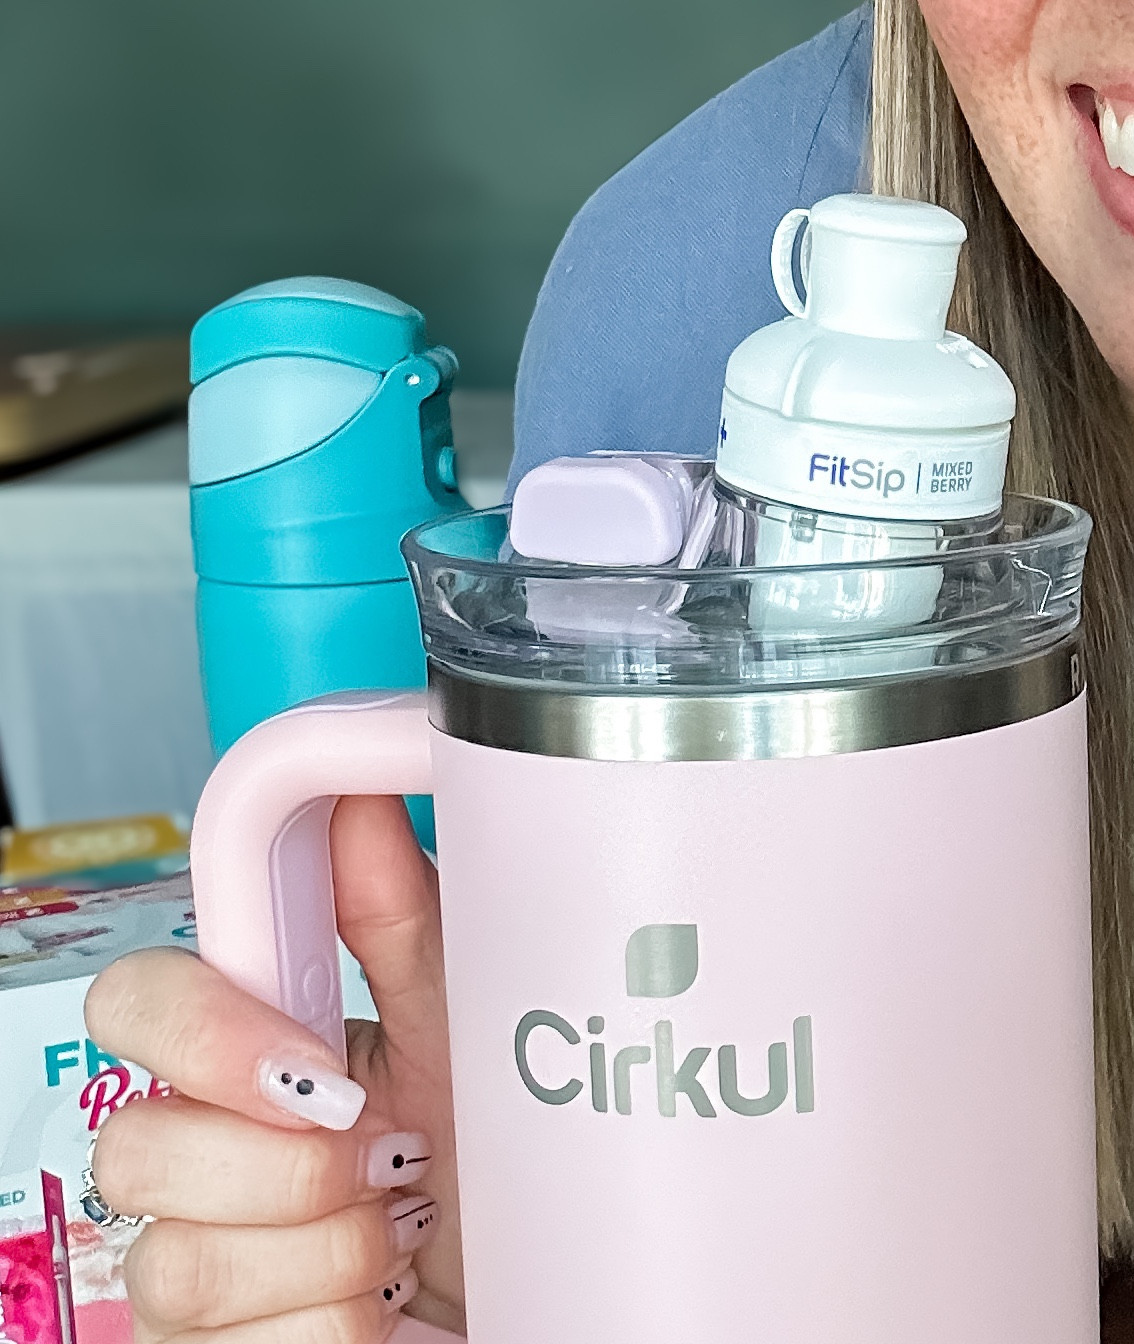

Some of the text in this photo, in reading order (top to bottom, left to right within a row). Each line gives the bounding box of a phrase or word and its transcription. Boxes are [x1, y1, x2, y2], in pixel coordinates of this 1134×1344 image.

[809, 452, 905, 498] FitSip
[930, 476, 973, 493] BERRY
[932, 461, 973, 477] MIXED
[514, 1009, 815, 1118] Cirkul
